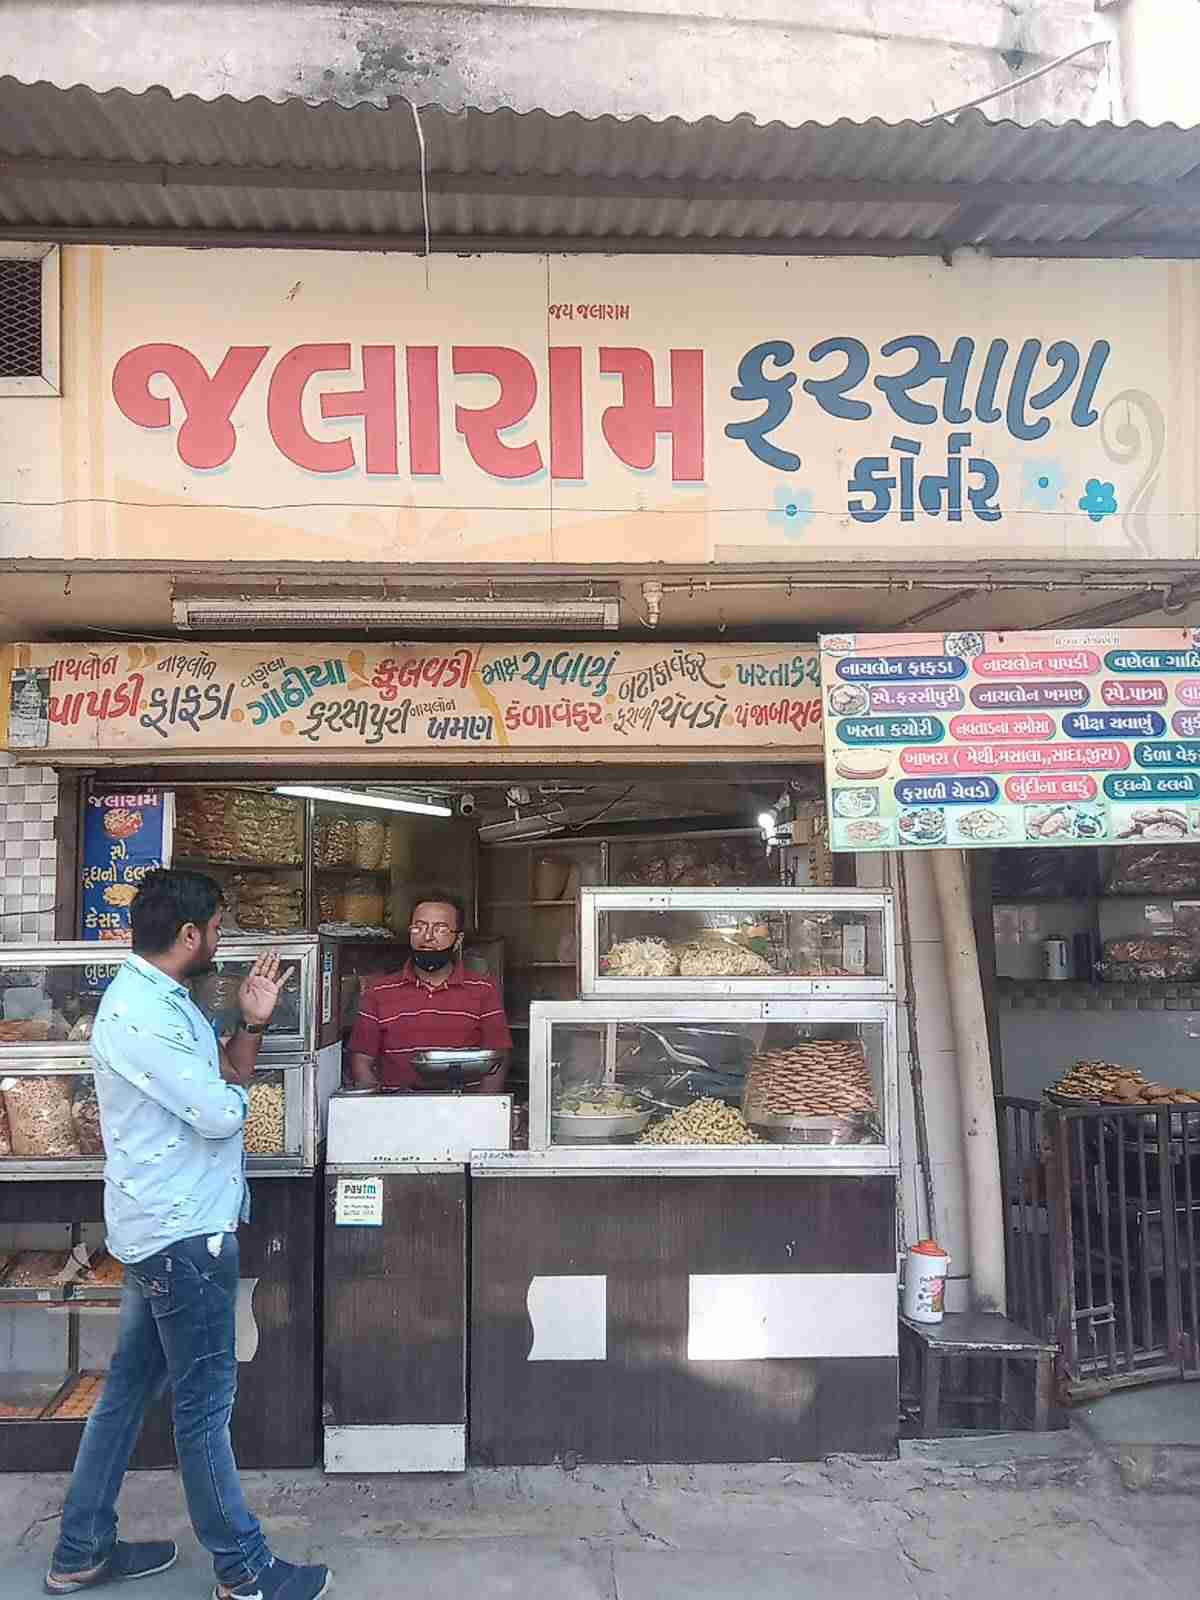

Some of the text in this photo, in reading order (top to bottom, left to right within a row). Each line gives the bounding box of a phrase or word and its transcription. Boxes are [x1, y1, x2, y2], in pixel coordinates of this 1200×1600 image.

[548, 303, 630, 320] જય જલારામ
[111, 342, 706, 484] જલારામ
[724, 335, 1110, 472] ફરસાણ
[841, 659, 953, 677] નાયલોન ફાફડા
[983, 653, 1089, 673] નાયલોન પાપડી
[1113, 651, 1160, 669] વણેલા
[49, 672, 145, 726] પાપડી
[979, 684, 1084, 703] નાયલોન ખમણ
[139, 682, 236, 738] ફાફડા
[426, 715, 494, 740] ખમણ
[845, 717, 934, 738] ખસ્તા કચોરી
[904, 751, 949, 766] ખાખરા
[1142, 745, 1200, 763] કેળા વેફ
[88, 794, 158, 808] જલારામ
[902, 781, 991, 801] ફરાળી ચેવડો
[85, 907, 121, 928] કેસર
